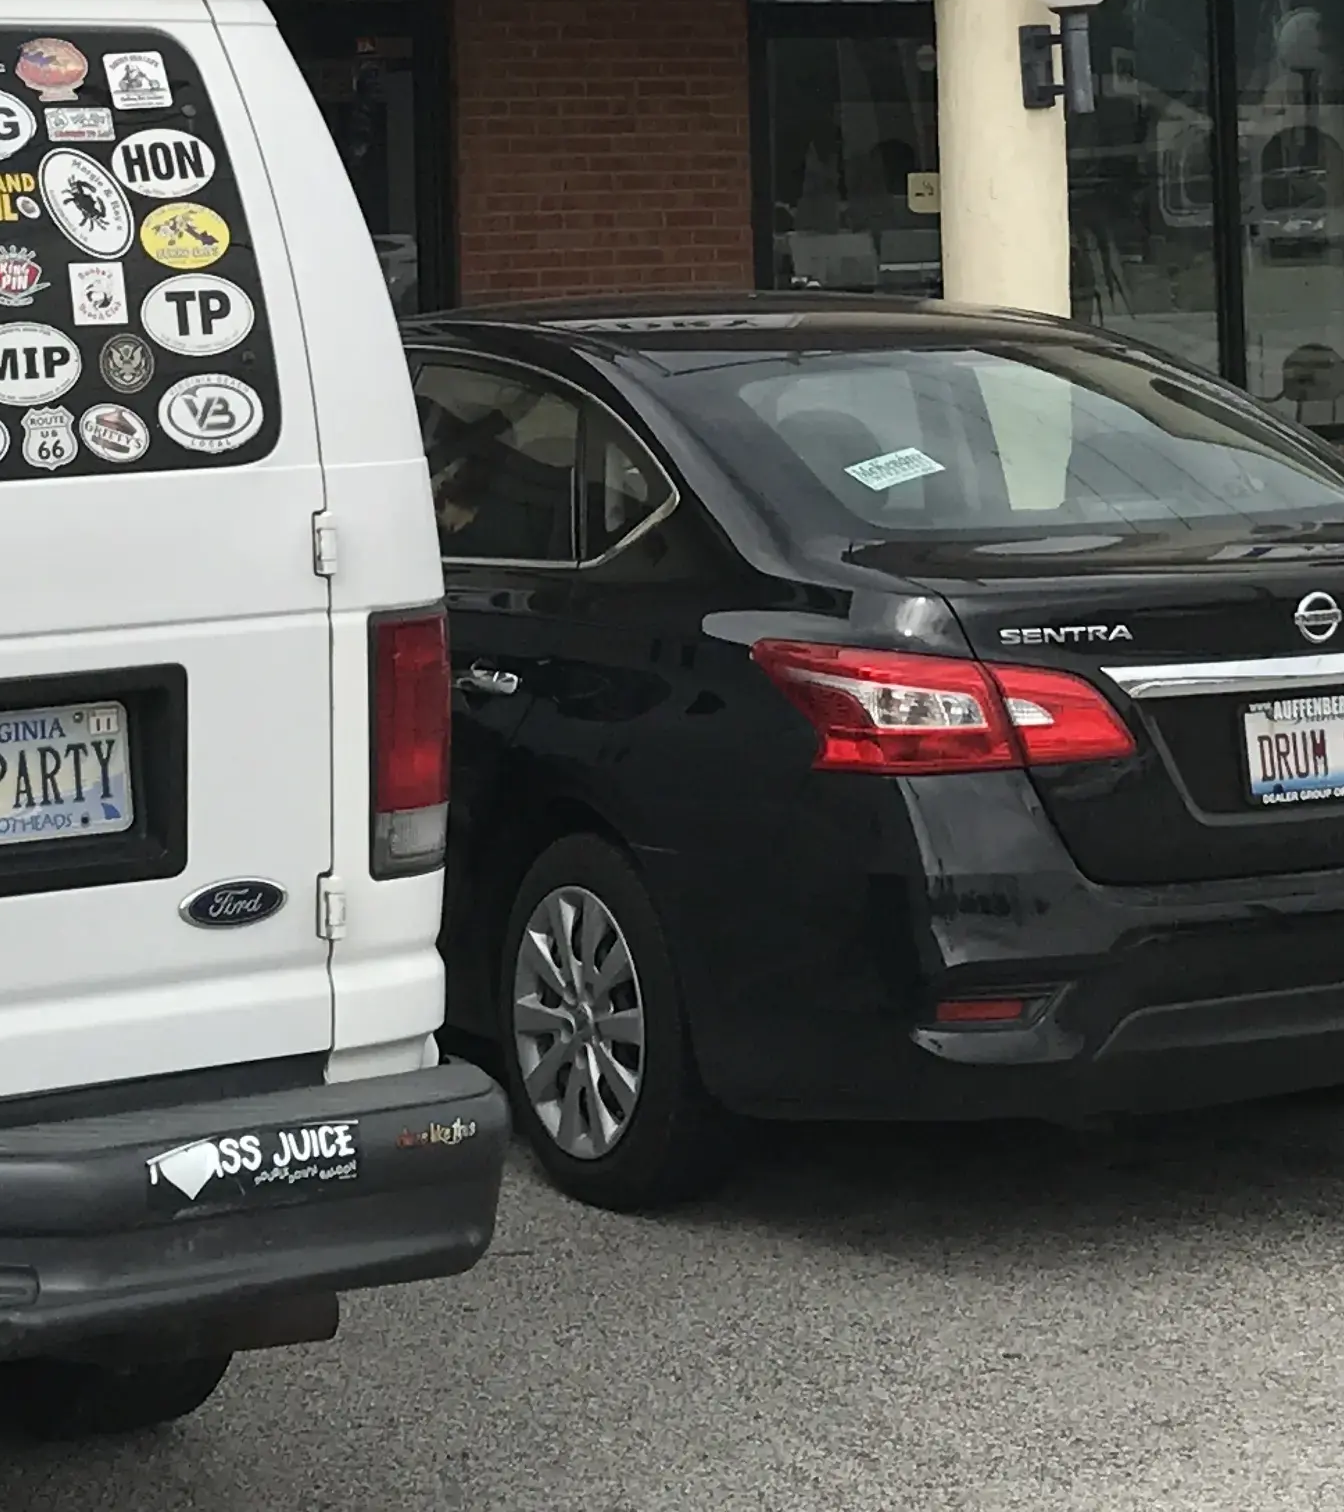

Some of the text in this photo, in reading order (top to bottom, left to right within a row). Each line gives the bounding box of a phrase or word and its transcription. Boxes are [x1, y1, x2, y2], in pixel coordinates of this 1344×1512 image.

[71, 159, 104, 188] Margie
[121, 141, 205, 183] HON
[1, 275, 29, 290] PIN
[164, 290, 232, 337] TP
[30, 416, 65, 426] ROUTE
[182, 397, 236, 431] VB
[40, 430, 59, 438] US
[191, 439, 232, 448] LOCAL
[38, 440, 65, 460] 66
[1000, 624, 1133, 645] SENTRA
[1258, 729, 1329, 782] DRUM
[1262, 791, 1299, 805] DEALER
[1300, 788, 1332, 801] GROUP
[208, 889, 262, 917] Ford
[272, 1125, 356, 1167] JUICE
